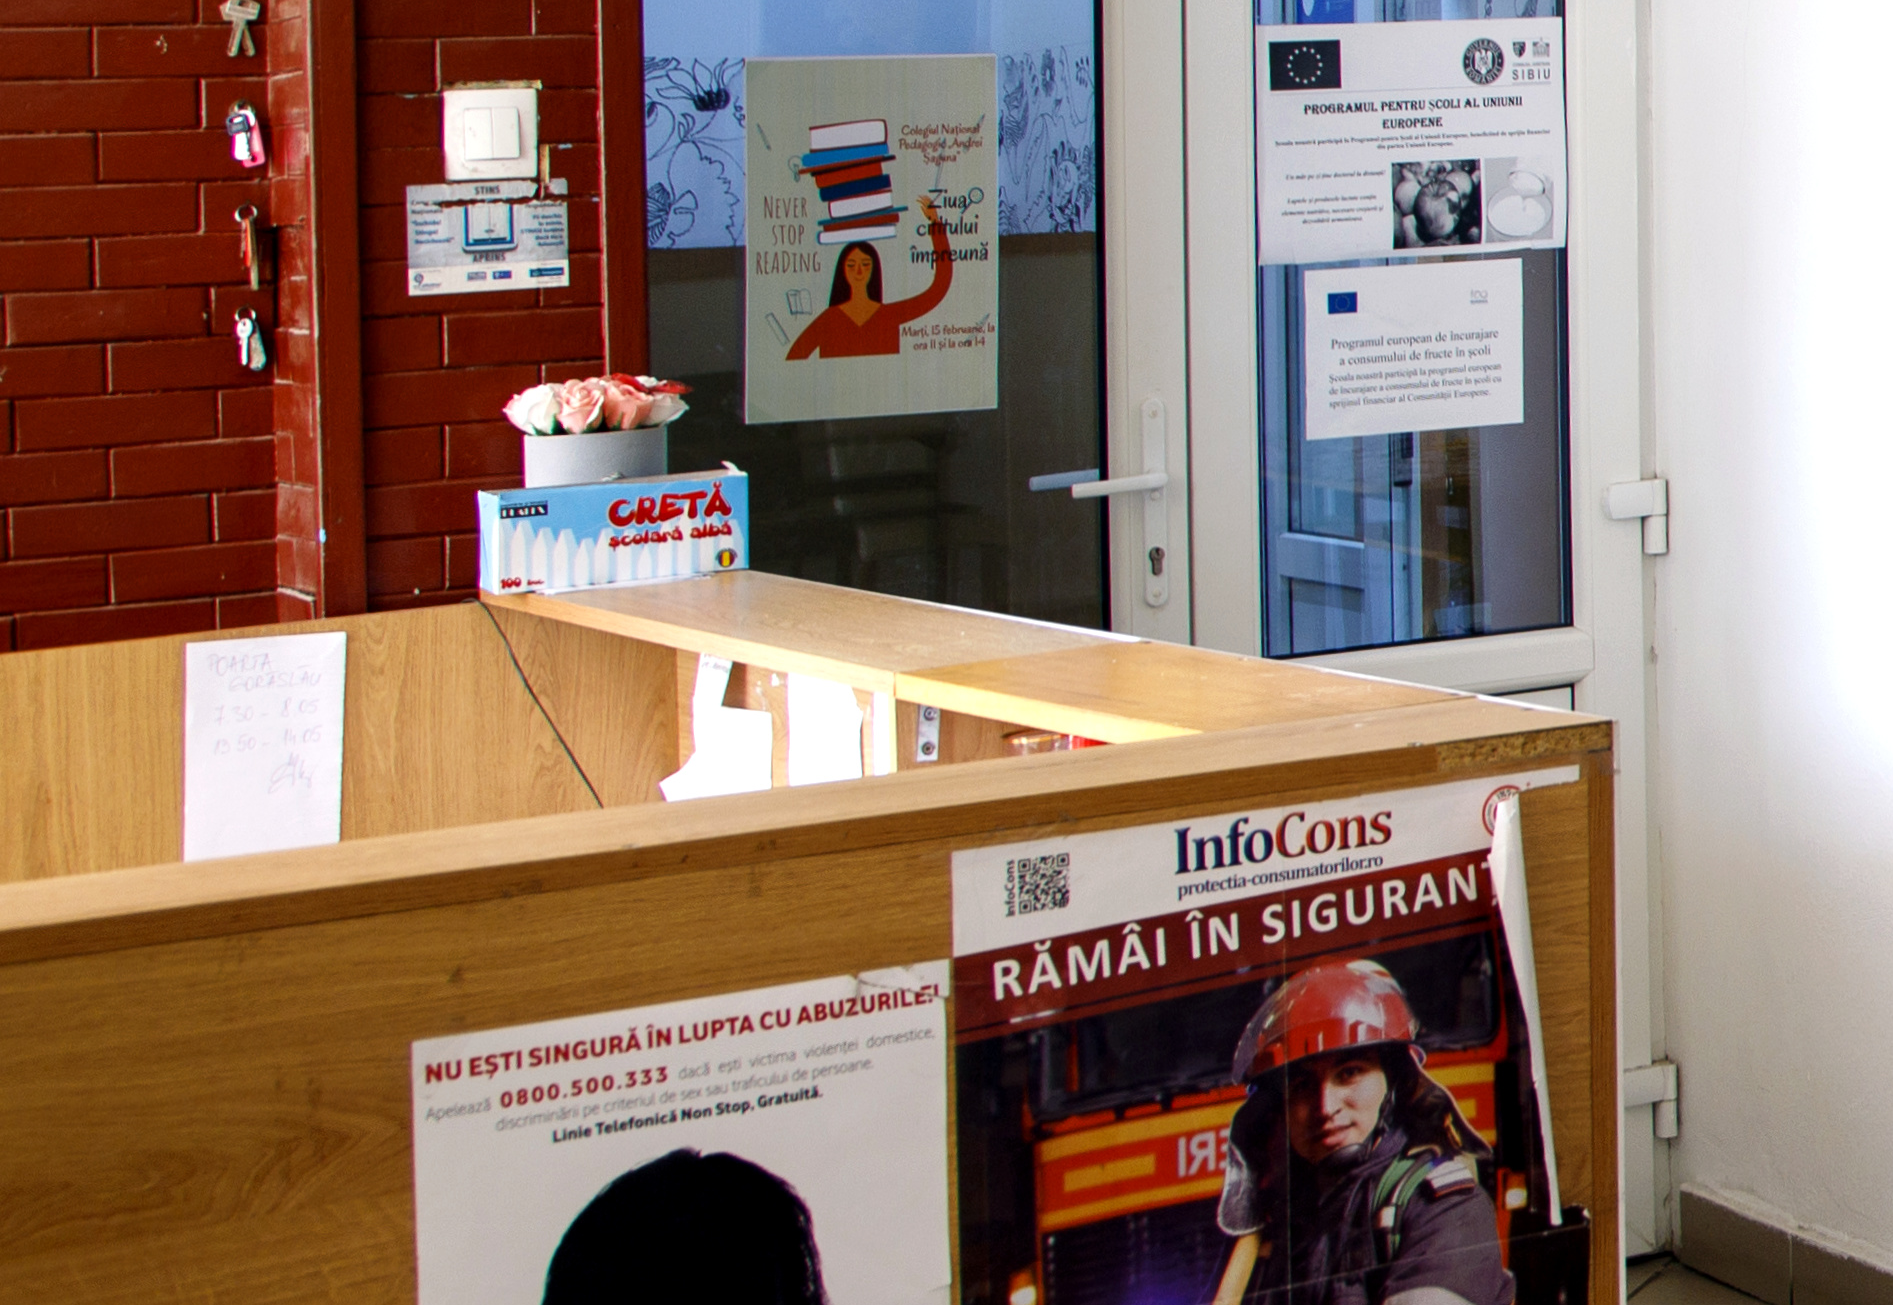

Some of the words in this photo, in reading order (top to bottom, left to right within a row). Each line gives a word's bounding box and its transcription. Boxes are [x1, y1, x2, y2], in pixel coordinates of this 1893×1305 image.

[1512, 68, 1551, 81] SIBIU
[1304, 101, 1378, 115] PROGRAMUL
[1381, 100, 1425, 112] PENTRU
[1428, 98, 1461, 112] ȘCOLI
[1464, 97, 1480, 109] AL
[1482, 96, 1523, 108] UNIUNII
[1382, 116, 1443, 129] EUROPENE
[475, 185, 500, 195] STINS
[928, 189, 968, 210] Ziua
[763, 195, 808, 219] NEVER
[771, 223, 806, 247] STOP
[755, 250, 822, 275] READING
[910, 241, 988, 269] împreună
[1331, 336, 1384, 351] Programul
[1386, 334, 1432, 346] european
[1435, 331, 1447, 342] de
[1450, 328, 1499, 342] încurajare
[1348, 349, 1406, 365] consumului
[1409, 349, 1422, 361] de
[1424, 347, 1453, 360] fructe
[1468, 345, 1491, 359] școli
[607, 481, 732, 527] CRETĂ
[608, 527, 683, 551] școlară
[690, 520, 732, 540] albă
[500, 577, 521, 589] 100
[1174, 808, 1393, 875] InfoCons
[1004, 859, 1017, 918] InfoCons
[1177, 854, 1384, 901] protectia-consumatorilor.ro
[993, 922, 1167, 1002] RĂMÂI
[1184, 909, 1240, 961] ÎN
[425, 1059, 462, 1084] NU
[469, 1050, 522, 1079] EȘTI
[528, 1026, 641, 1068] SINGURĂ
[647, 1024, 672, 1049] ÎN
[678, 1014, 755, 1045] LUPTA
[760, 1009, 791, 1031] CU
[425, 1098, 492, 1122] Apelează
[500, 1065, 669, 1109] 0800.500.333
[552, 1125, 592, 1143] Linie
[595, 1109, 678, 1136] Telefonică
[680, 1100, 712, 1122] Non
